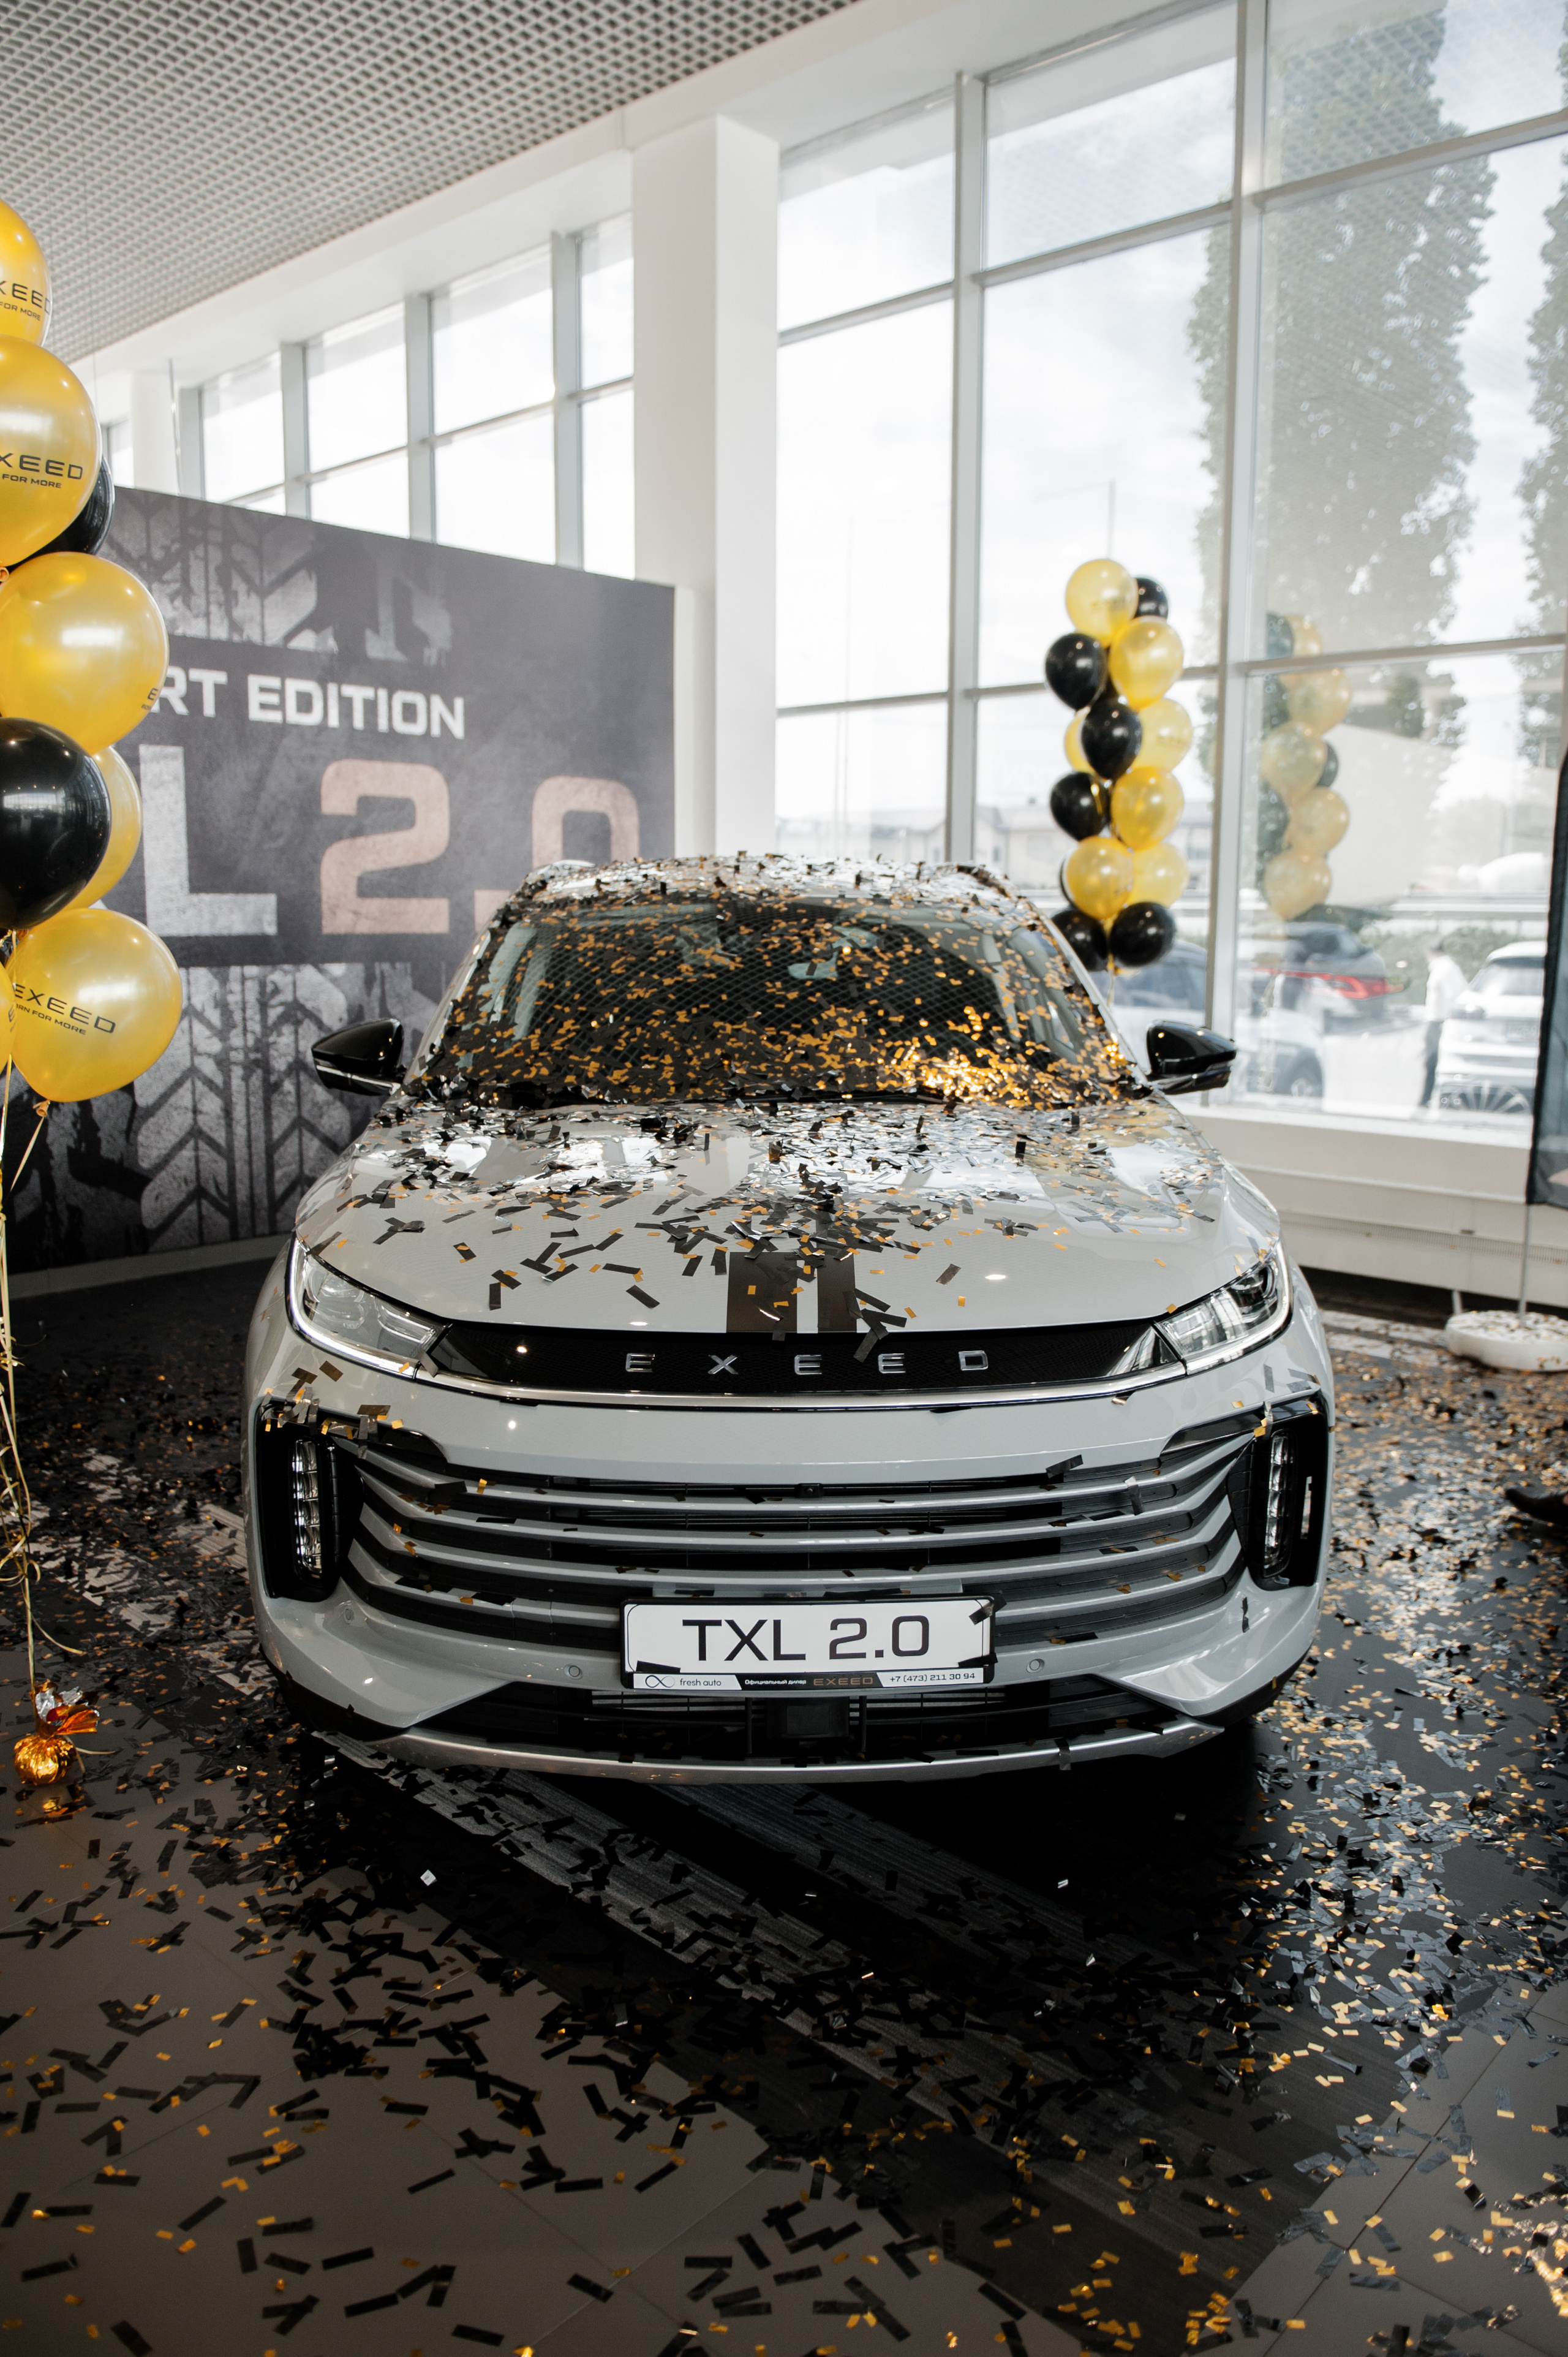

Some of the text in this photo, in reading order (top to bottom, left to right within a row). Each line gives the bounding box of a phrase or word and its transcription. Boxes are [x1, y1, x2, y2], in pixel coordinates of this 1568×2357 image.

[20, 308, 41, 321] MORE
[2, 474, 62, 488] FOR MORE
[247, 673, 465, 740] EDITION
[15, 983, 116, 1034] EXEED
[32, 1010, 52, 1022] FOR
[55, 1019, 87, 1035] MORE
[625, 1350, 989, 1375] EXEED
[682, 1615, 930, 1662] TXL 2.0
[813, 1677, 873, 1685] EXEED
[903, 1674, 927, 1682] (473)
